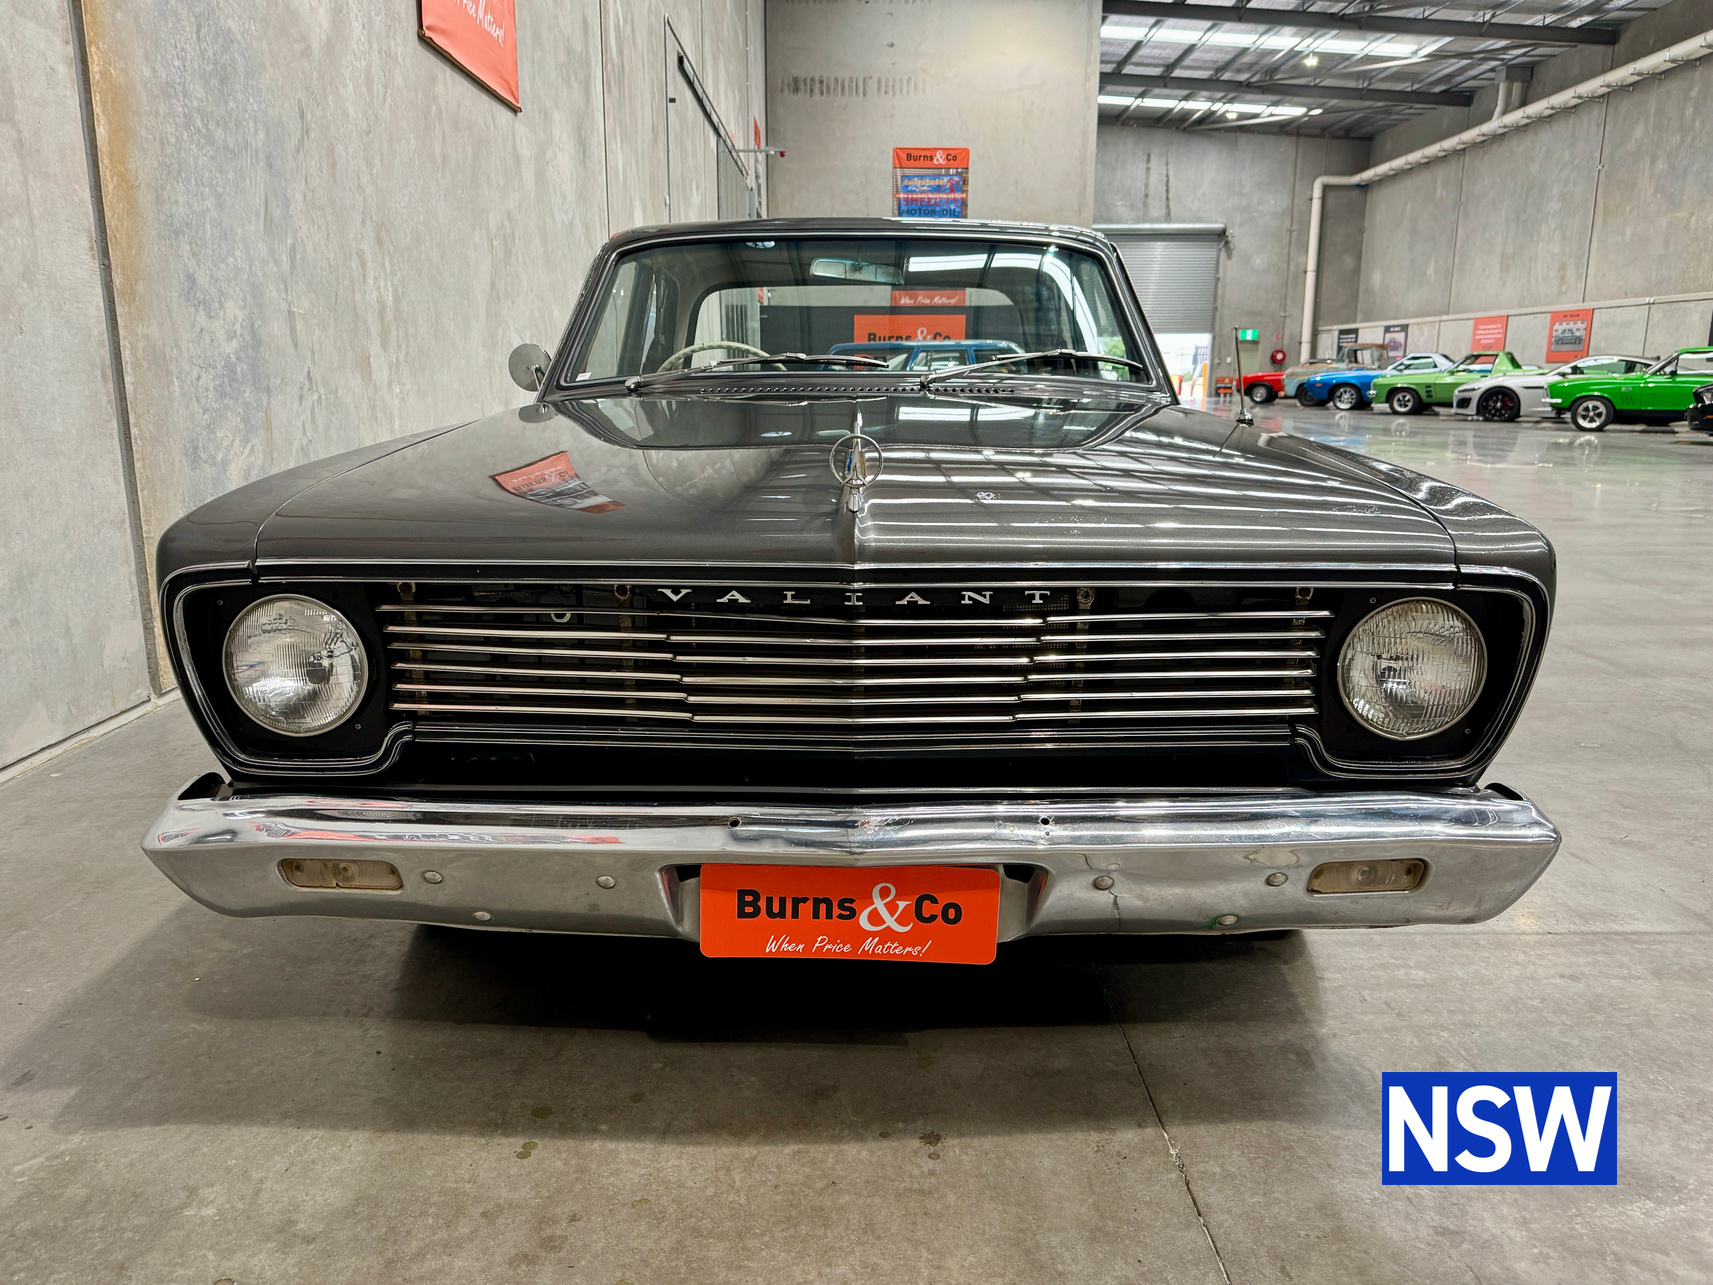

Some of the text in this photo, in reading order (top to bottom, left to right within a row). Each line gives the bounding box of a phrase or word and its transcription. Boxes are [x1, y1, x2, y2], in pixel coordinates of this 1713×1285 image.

[905, 150, 958, 165] Burns&Co
[901, 208, 959, 217] MOTOR OIL
[656, 588, 1051, 605] VALIANT
[736, 882, 963, 933] Burns&Co
[765, 934, 932, 956] When Price Matters!
